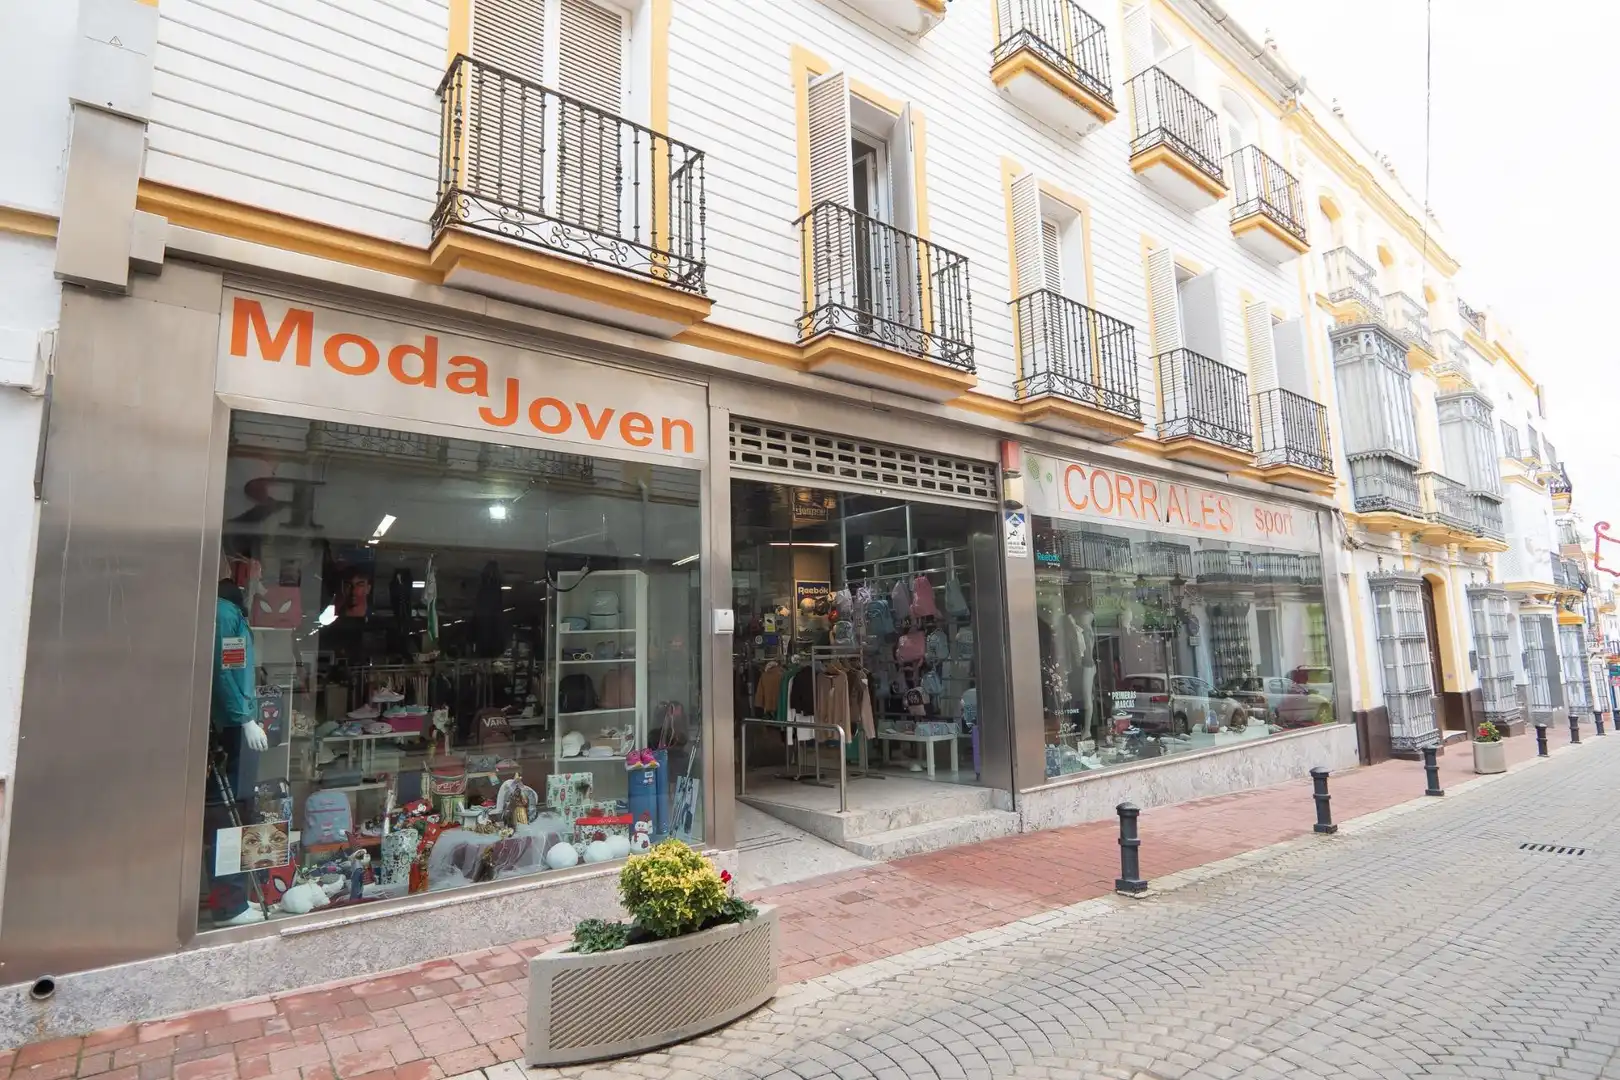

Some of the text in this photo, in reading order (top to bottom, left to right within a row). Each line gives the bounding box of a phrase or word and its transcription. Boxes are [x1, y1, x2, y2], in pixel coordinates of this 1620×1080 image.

[230, 297, 694, 453] Moda Joven
[1064, 463, 1294, 538] CORRALES sport
[1036, 552, 1060, 562] Reebok
[798, 586, 829, 595] Reebok
[1112, 691, 1136, 700] PRIMERAS
[1115, 700, 1135, 708] MARCAS
